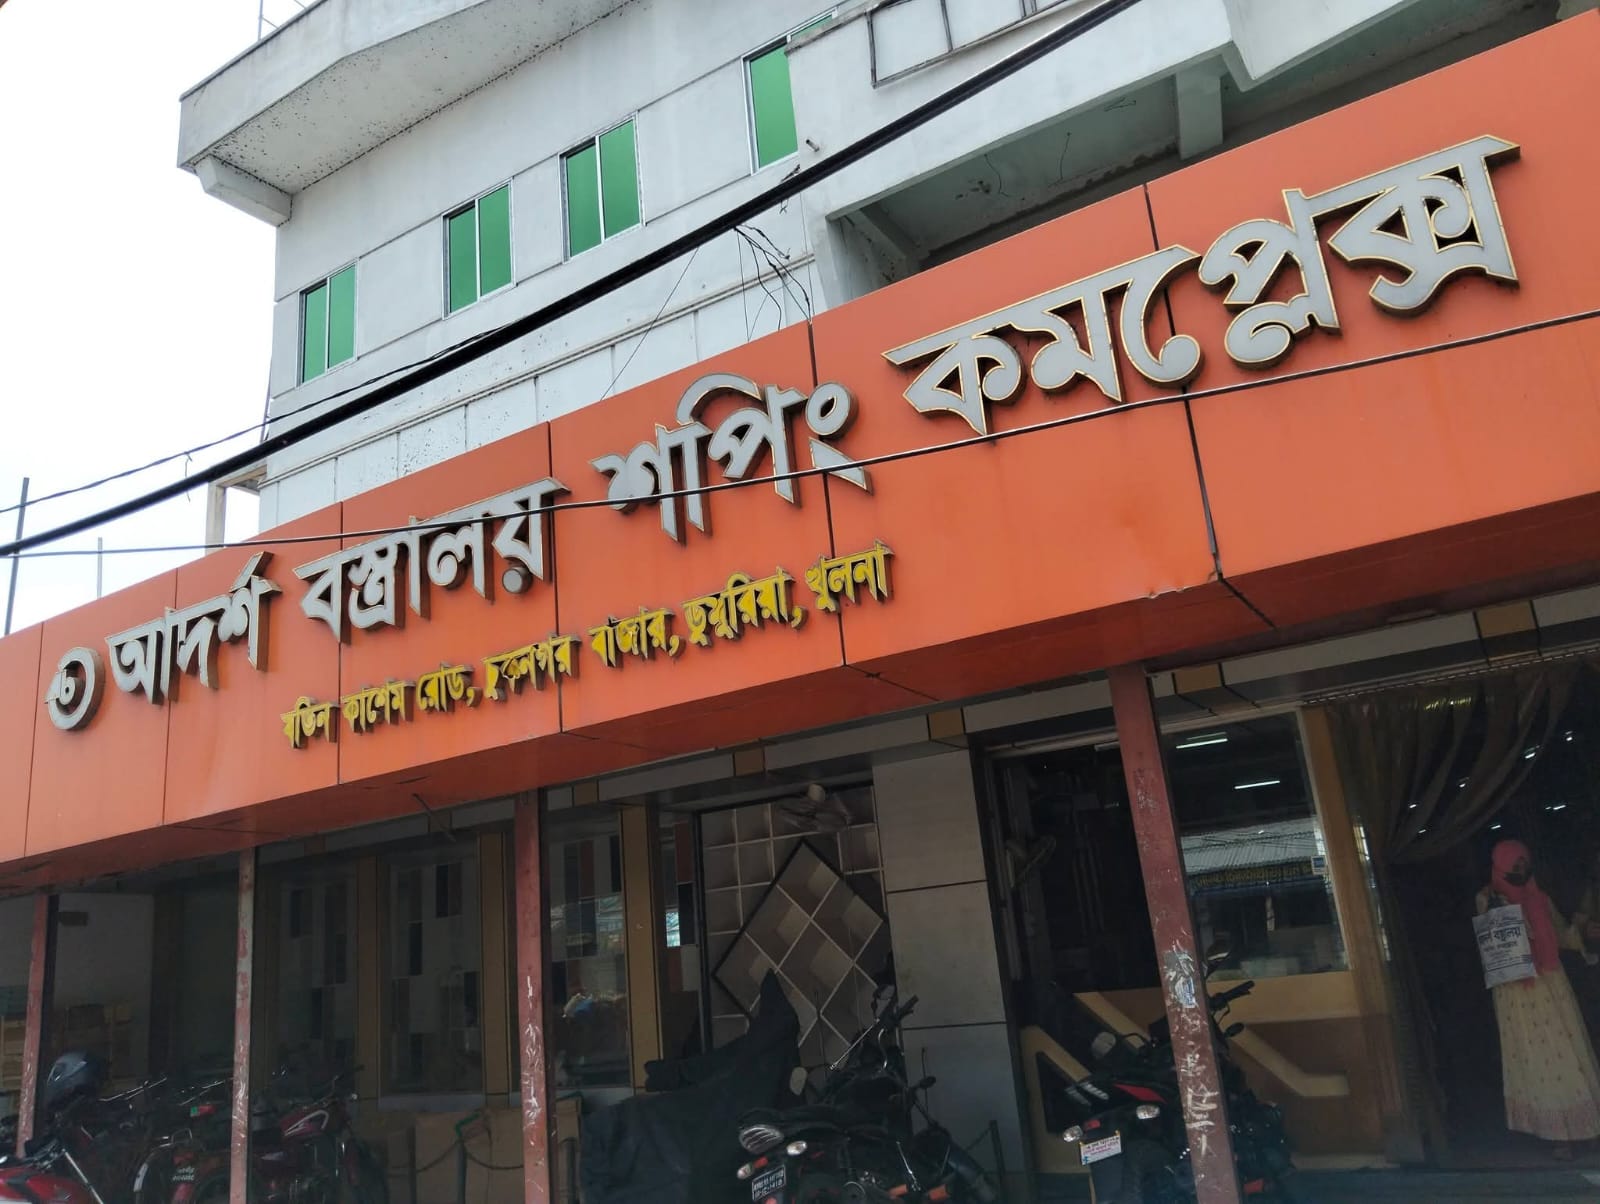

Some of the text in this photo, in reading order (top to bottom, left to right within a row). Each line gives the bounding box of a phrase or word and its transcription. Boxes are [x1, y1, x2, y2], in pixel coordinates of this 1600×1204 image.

[105, 134, 1520, 704] আদর্শ বস্ত্রালয় শপিং কমপ্লেক্স
[340, 679, 416, 734] কাশেম
[416, 661, 483, 712] রোড,
[587, 605, 685, 668] বাজার,
[806, 540, 895, 613] খুলনা
